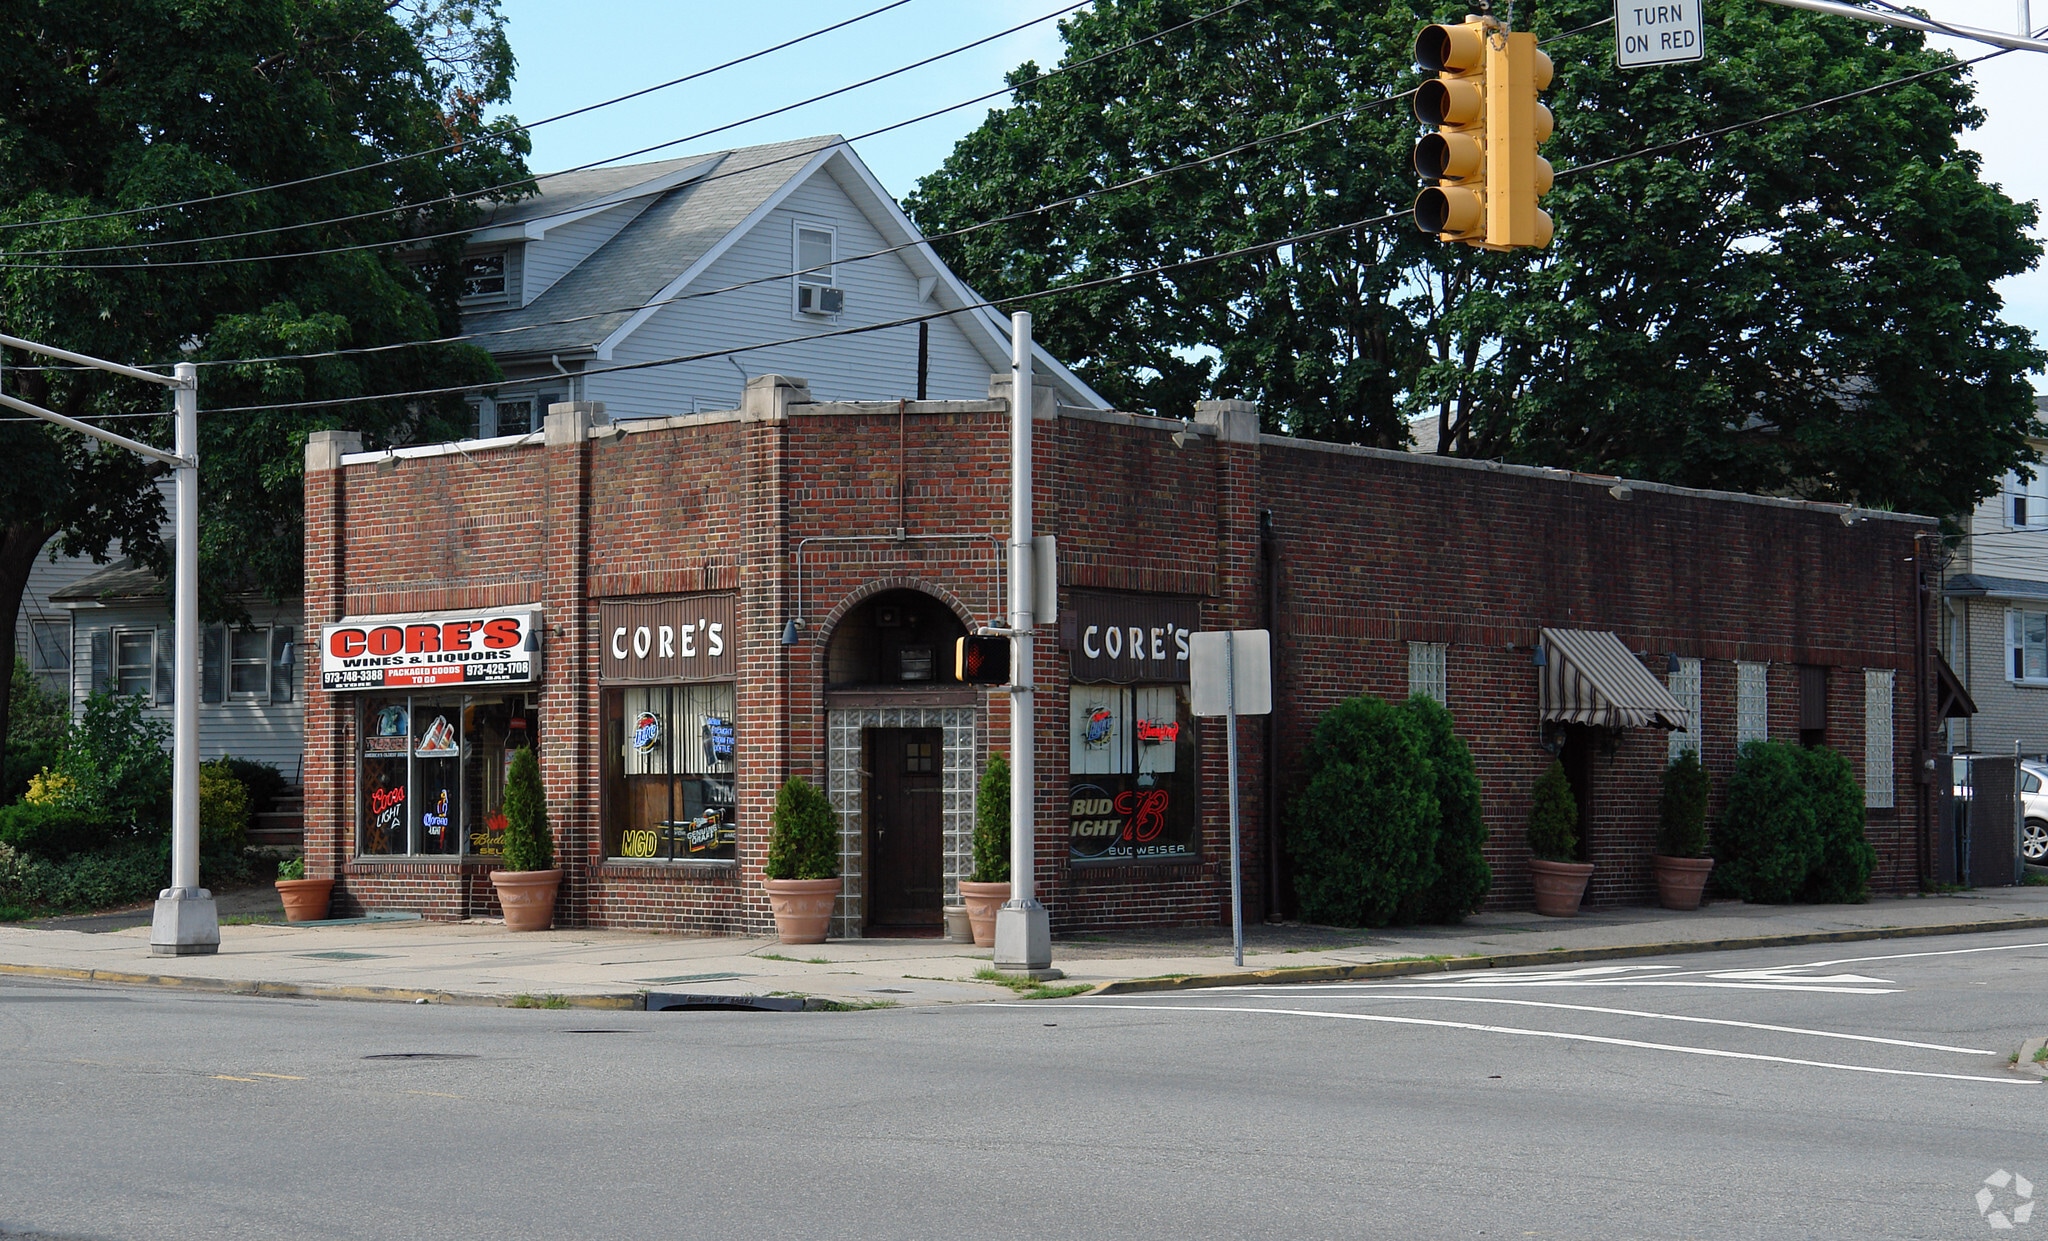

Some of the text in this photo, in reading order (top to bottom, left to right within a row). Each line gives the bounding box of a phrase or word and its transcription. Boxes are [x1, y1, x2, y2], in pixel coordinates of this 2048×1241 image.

[1633, 4, 1682, 26] TURN
[1625, 30, 1695, 53] ON RED
[330, 617, 521, 658] CORE'S
[612, 618, 724, 660] CORE'S
[1083, 623, 1190, 661] CORE'S
[343, 650, 511, 668] WINES & LIQUORS
[466, 661, 529, 676] 973-429-1708
[324, 669, 383, 684] 973-748-3388
[388, 666, 461, 677] PACKAGED GOODS
[411, 675, 436, 684] TO GO
[372, 785, 406, 814] Coors
[1071, 798, 1113, 816] BUD
[376, 803, 402, 828] LIGHT
[1070, 819, 1122, 837] IGHT
[621, 829, 658, 858] MGD
